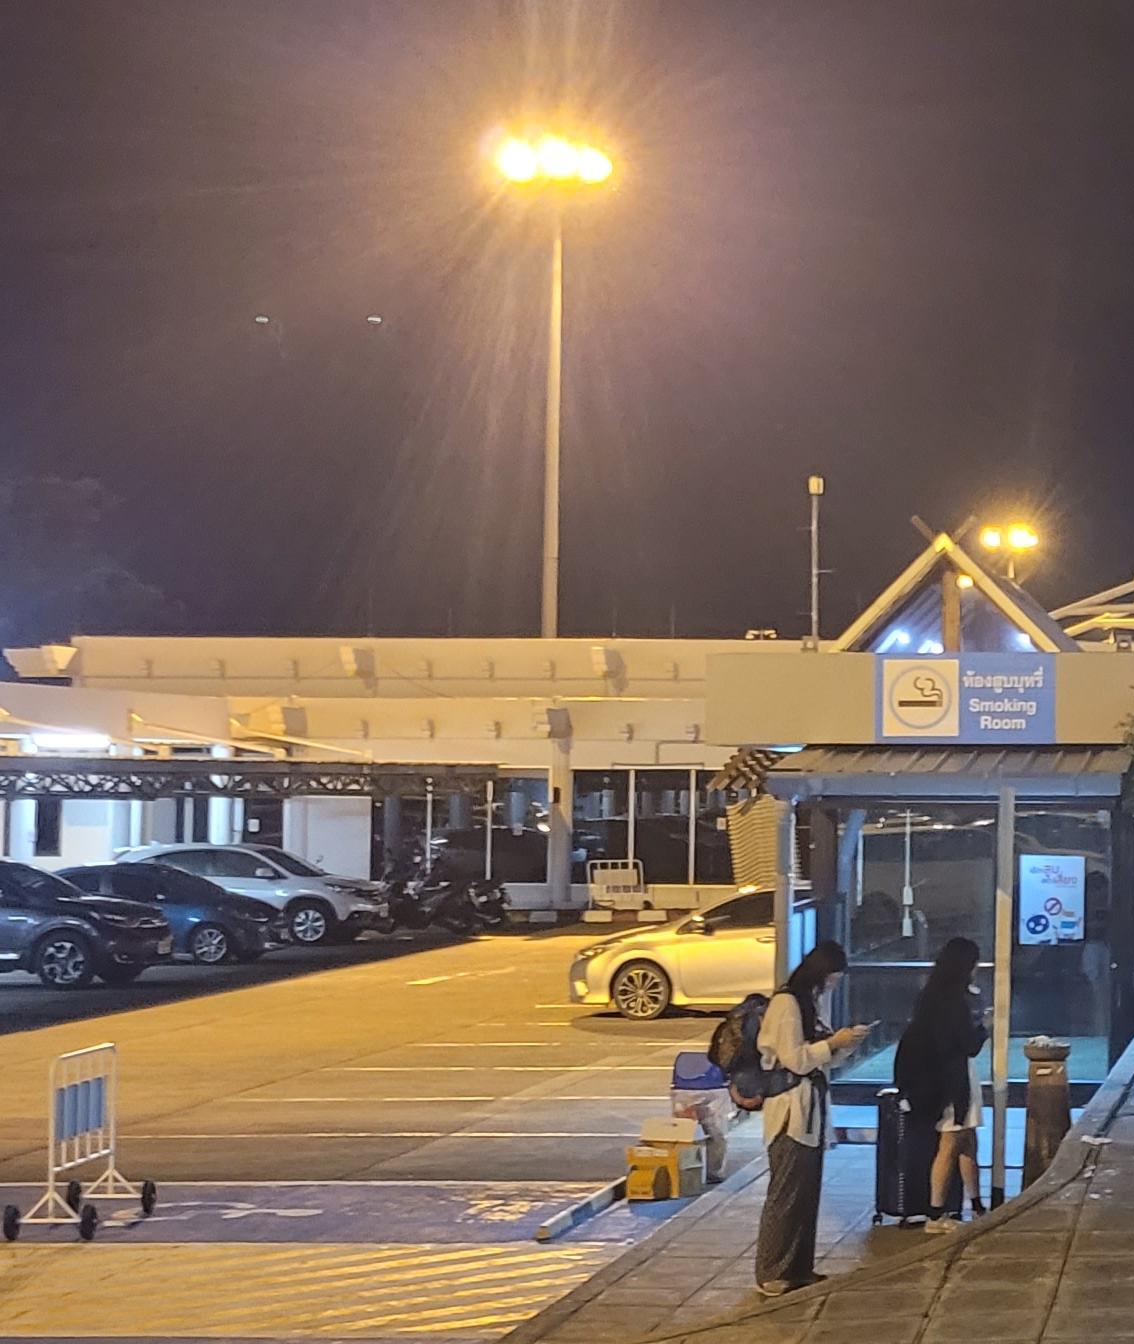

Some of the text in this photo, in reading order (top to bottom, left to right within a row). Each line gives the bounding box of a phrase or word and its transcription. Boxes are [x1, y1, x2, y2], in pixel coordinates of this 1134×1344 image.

[963, 666, 1043, 693] ห้องสูบบุหรี่
[969, 698, 1036, 715] Smoking
[980, 716, 1026, 729] Room
